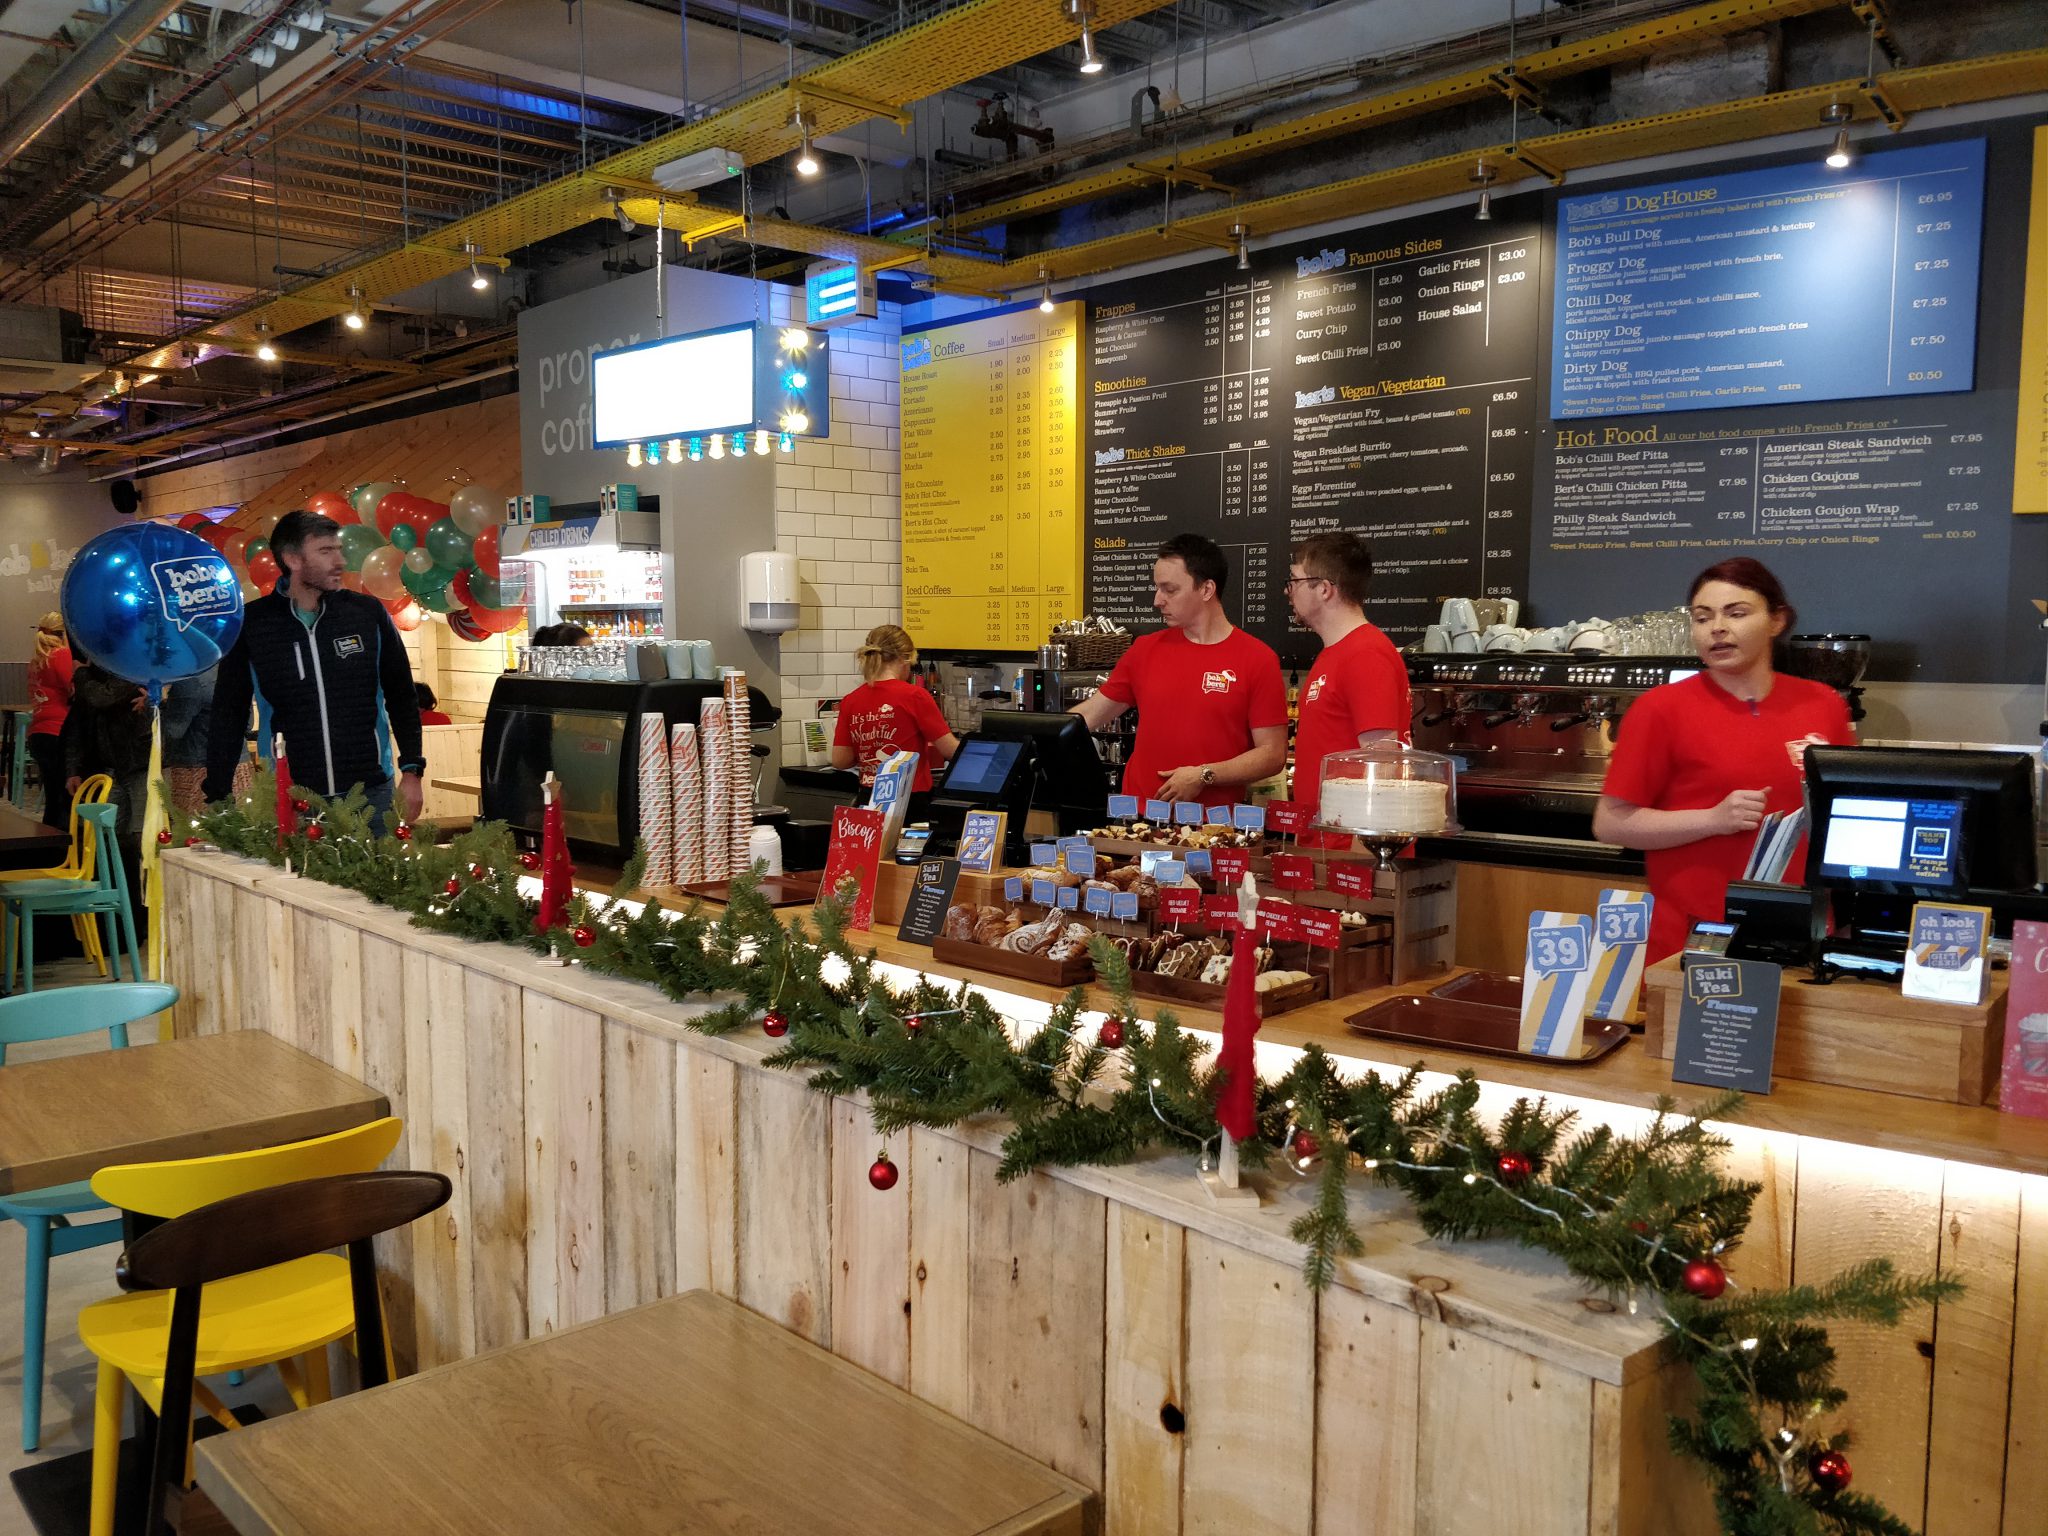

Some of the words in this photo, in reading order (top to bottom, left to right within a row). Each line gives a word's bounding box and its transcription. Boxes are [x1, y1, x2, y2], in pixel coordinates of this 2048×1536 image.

[1918, 191, 1952, 204] £6.95
[1566, 194, 1620, 223] berts
[1625, 192, 1661, 211] Dog
[1662, 188, 1719, 208] House
[1916, 221, 1952, 233] £7.25
[1568, 235, 1601, 249] Bob's
[1605, 230, 1630, 244] Bull
[1635, 229, 1662, 244] Dog
[1296, 246, 1346, 279] bobs
[1349, 247, 1401, 266] Famous
[1404, 239, 1442, 255] Sides
[1497, 248, 1526, 261] £3.00
[1418, 263, 1450, 277] Garlic
[1453, 258, 1481, 271] Fries
[1567, 261, 1615, 275] Froggy
[1618, 257, 1646, 269] Dog
[1914, 259, 1949, 271] £7.25
[1378, 274, 1403, 286] £2.50
[1496, 271, 1527, 284] £3.00
[1295, 285, 1330, 300] French
[1331, 280, 1358, 294] Fries
[1418, 286, 1450, 298] Onion
[1452, 279, 1485, 292] Rings
[1378, 295, 1402, 307] £3.00
[1566, 295, 1601, 308] Chilli
[1605, 293, 1632, 305] Dog
[1913, 297, 1948, 308] £7.25
[1095, 303, 1137, 318] Frappes
[1295, 308, 1325, 321] Sweet
[1325, 303, 1358, 317] Potato
[1418, 309, 1450, 321] House
[1451, 302, 1482, 317] Salad
[1378, 316, 1402, 327] £3.00
[1046, 327, 1067, 337] Large
[1296, 329, 1324, 340] Curry
[1325, 324, 1348, 335] Chip
[1565, 329, 1611, 341] Chippy
[1614, 325, 1642, 338] Dog
[1377, 340, 1401, 351] £3.00
[1910, 334, 1945, 346] £7.50
[933, 342, 965, 357] Coffee
[1294, 353, 1320, 365] Sweet
[1320, 349, 1344, 361] Chilli
[1345, 346, 1369, 357] Fries
[1564, 363, 1598, 375] Dirty
[1601, 360, 1629, 373] Dog
[1908, 370, 1943, 381] £0.50
[1094, 376, 1147, 393] Smoothies
[1340, 376, 1447, 398] Vegan/Vegetarian
[1094, 419, 1114, 427] Mango
[1293, 411, 1363, 425] Vegan/Vegetarian
[1365, 408, 1381, 418] Fry
[1556, 430, 1596, 449] Hot
[1603, 425, 1658, 446] Food
[1764, 443, 1824, 453] American
[1827, 439, 1864, 450] Steak
[1867, 436, 1932, 448] Sandwich
[1124, 447, 1151, 460] Thick
[1152, 445, 1187, 458] Shakes
[1293, 450, 1317, 459] Vegan
[1319, 445, 1357, 456] Breakfast
[1359, 442, 1391, 452] Burrito
[1555, 455, 1583, 465] Bob's
[1585, 453, 1613, 463] Chilli
[1616, 451, 1641, 462] Beef
[1642, 450, 1669, 460] Pitta
[1762, 474, 1808, 484] Chicken
[1811, 472, 1860, 483] Goujons
[1292, 485, 1313, 495] Eggs
[1314, 482, 1357, 491] Florentine
[1554, 484, 1584, 494] Bert's
[1586, 482, 1613, 493] Chilli
[1615, 481, 1658, 491] Chicken
[1661, 479, 1688, 489] Pitta
[1553, 514, 1585, 525] Philly
[1587, 513, 1619, 523] Steak
[1621, 511, 1676, 522] Sandwich
[1761, 507, 1812, 518] Chicken
[1815, 505, 1861, 517] Goujon
[1865, 503, 1900, 516] Wrap
[1094, 537, 1126, 549] Salads
[174, 581, 231, 607] berts
[906, 585, 922, 595] Iced
[922, 584, 952, 595] Coffees
[852, 712, 864, 725] It's
[866, 711, 879, 722] the
[875, 780, 894, 800] 20
[979, 818, 995, 827] look
[838, 817, 876, 850] Biscoff
[922, 863, 940, 873] Suki
[922, 873, 936, 882] Tea
[1313, 920, 1331, 930] JAMMY
[1604, 912, 1640, 939] 37
[1920, 916, 1939, 928] oh
[1942, 916, 1976, 929] look
[1920, 929, 1941, 941] it's
[1945, 933, 1954, 941] a
[1537, 937, 1579, 967] 39
[1695, 967, 1733, 981] Suki
[1700, 981, 1730, 994] Tea
[1706, 999, 1758, 1015] Flavours
